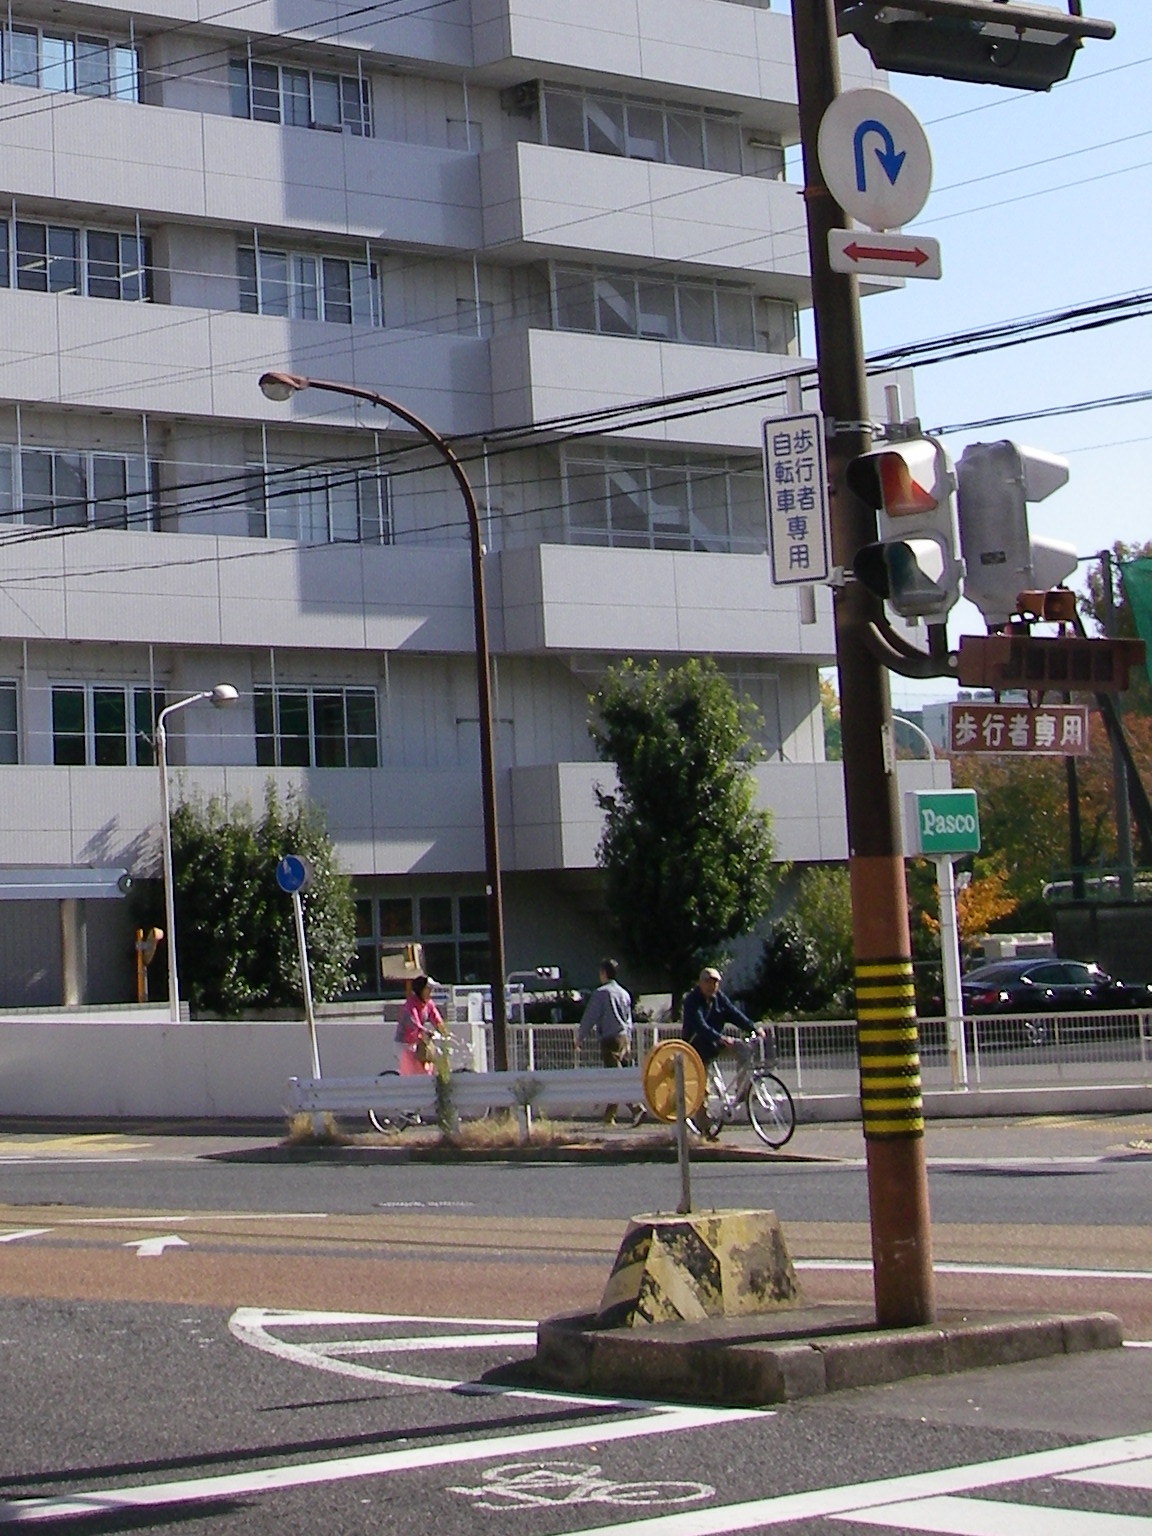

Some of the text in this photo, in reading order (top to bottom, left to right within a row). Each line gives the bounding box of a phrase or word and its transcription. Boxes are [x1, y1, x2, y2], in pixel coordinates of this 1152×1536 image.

[773, 431, 796, 514] 自転車
[793, 429, 817, 511] 歩行者
[786, 515, 810, 570] 専用
[955, 712, 1082, 747] 歩行者専用
[921, 809, 976, 836] Pasco
